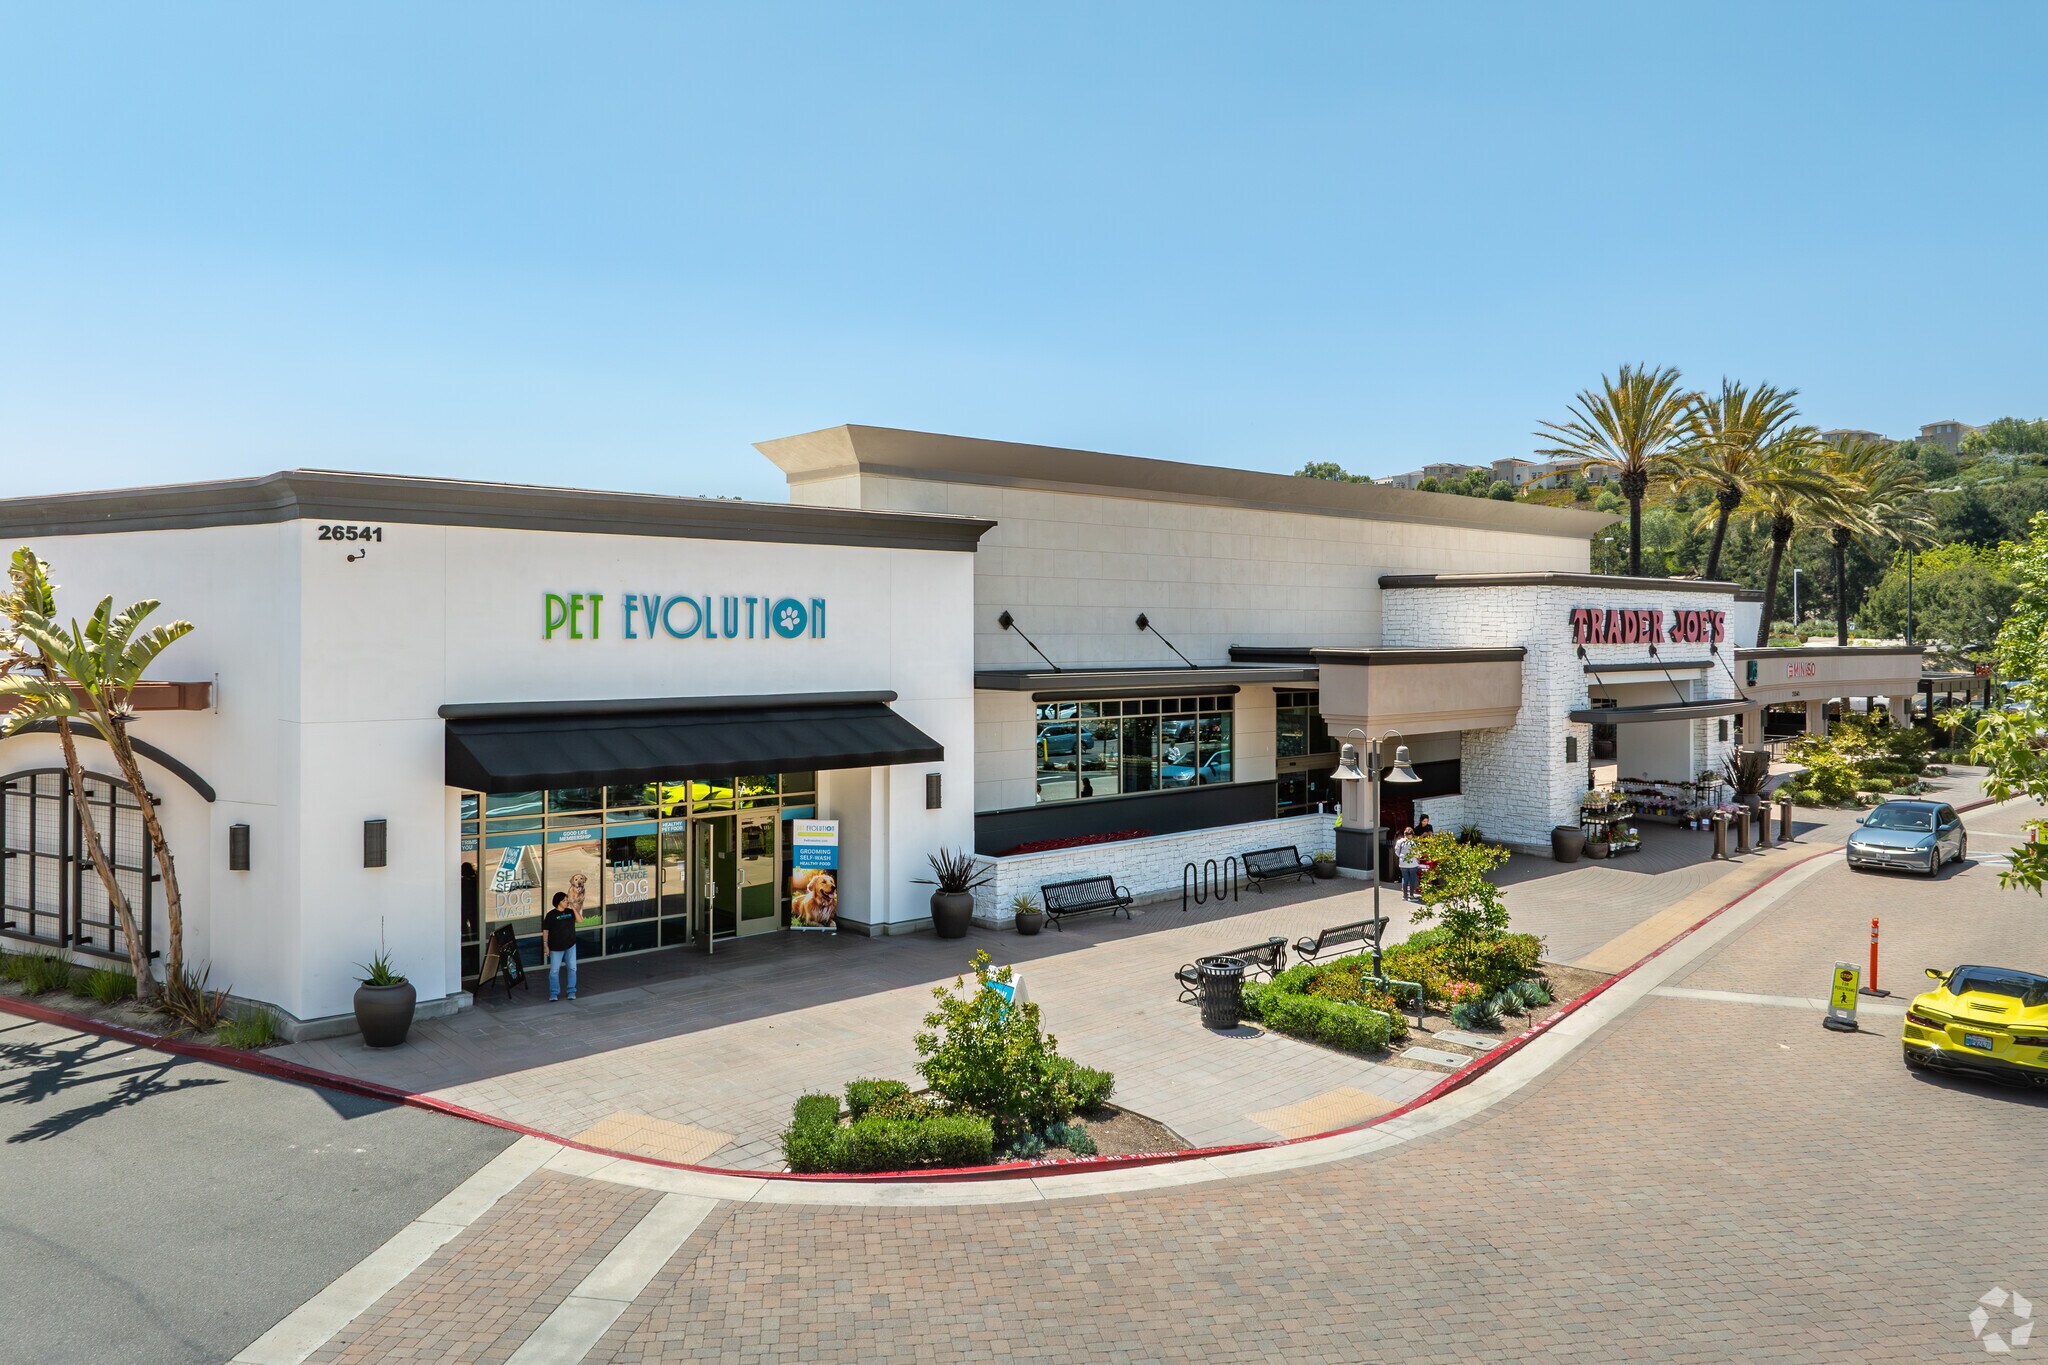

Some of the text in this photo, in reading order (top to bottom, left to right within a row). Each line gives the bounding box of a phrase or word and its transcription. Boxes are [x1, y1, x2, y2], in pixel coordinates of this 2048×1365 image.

[318, 525, 382, 542] 26541
[544, 593, 826, 640] PET EVOLUTION
[1569, 608, 1726, 644] TRADER JOE'S
[613, 858, 648, 874] FULL
[496, 868, 528, 882] SELF
[613, 870, 648, 881] SERVICE
[496, 880, 533, 892] SERVE
[613, 879, 649, 898] DOG
[495, 890, 533, 908] DOG
[613, 894, 649, 904] GROOMING
[495, 905, 533, 919] WASH
[1129, 1151, 1178, 1159] PARKING
